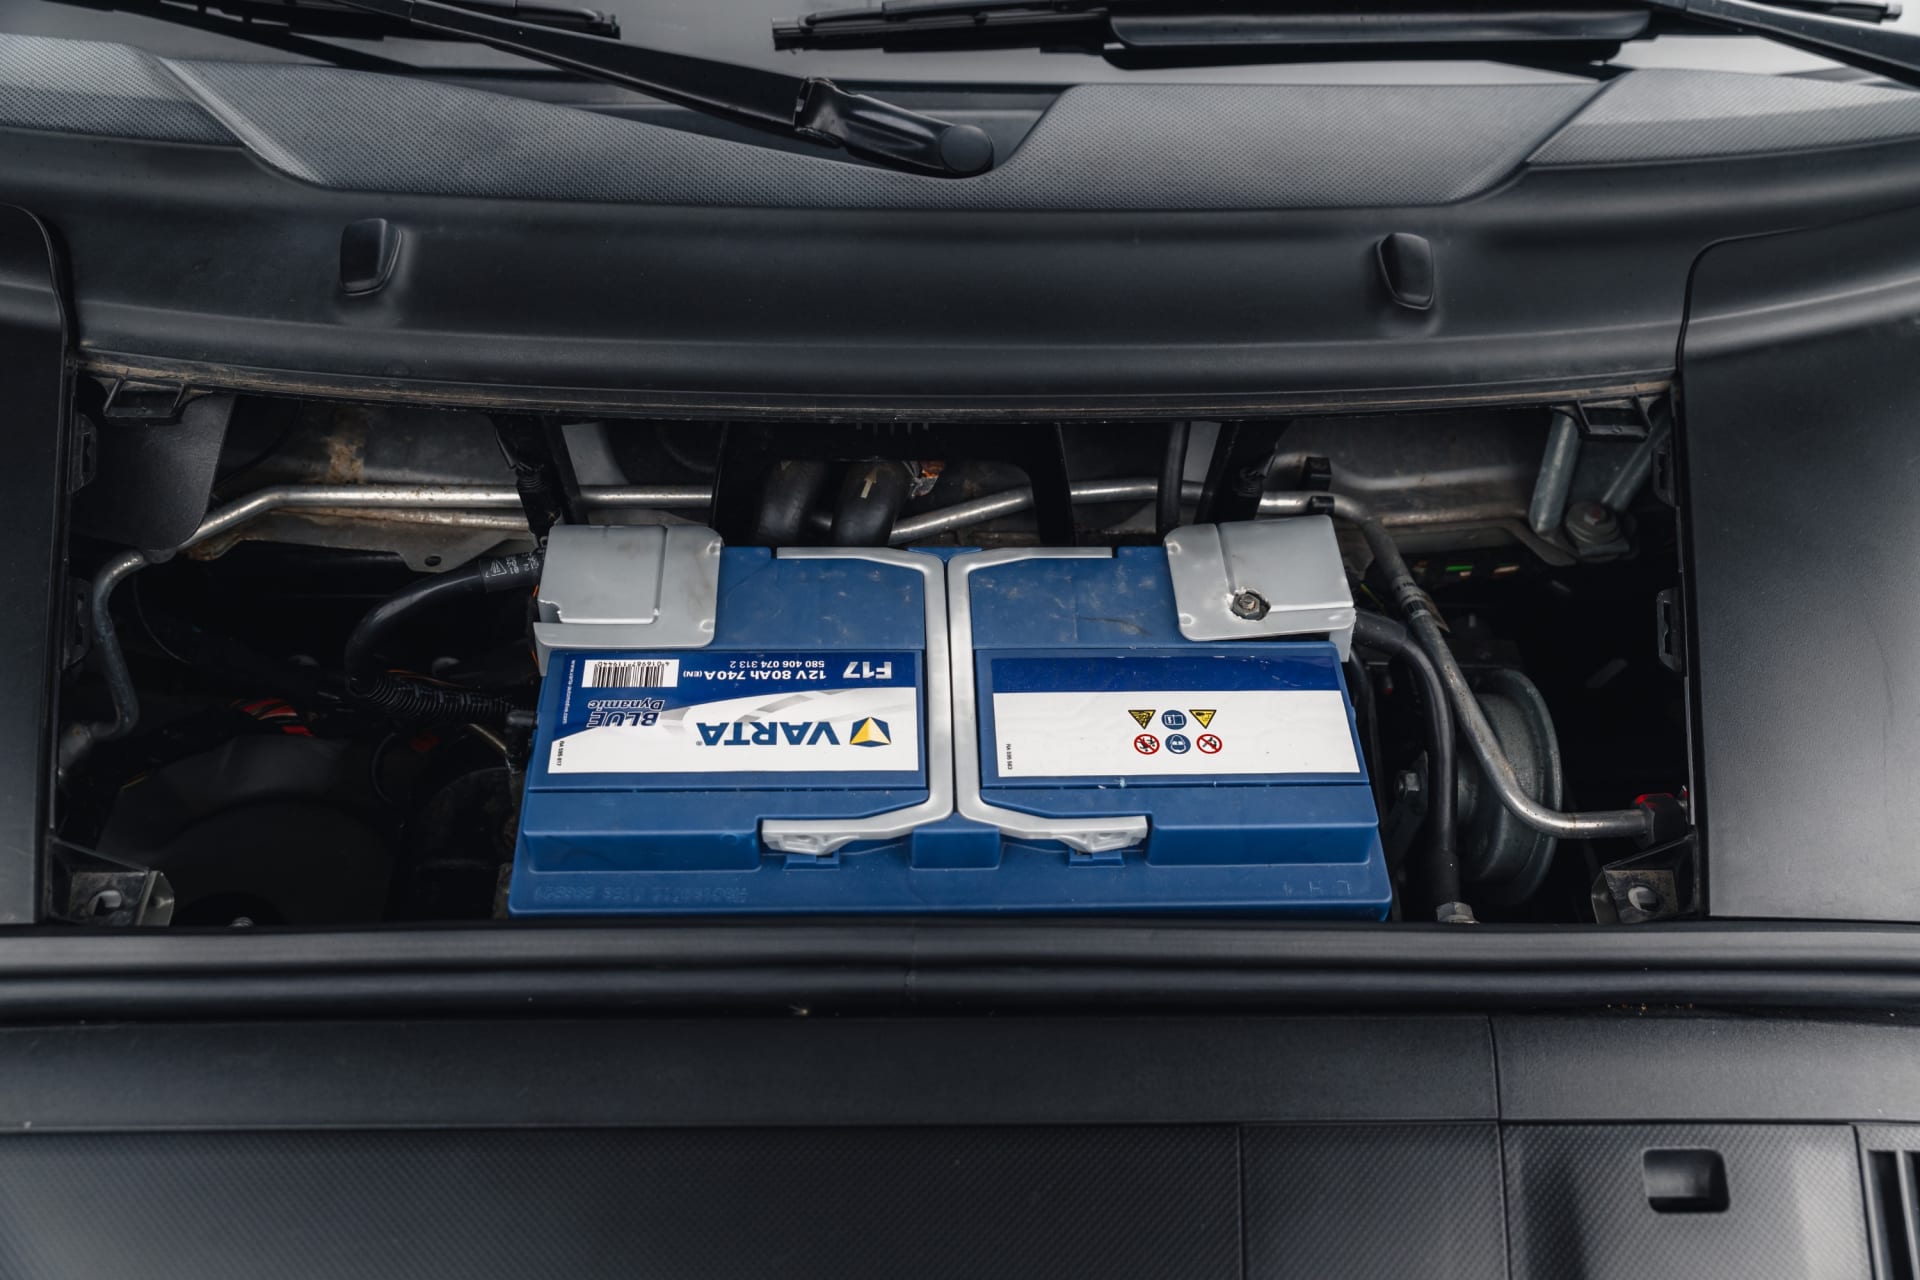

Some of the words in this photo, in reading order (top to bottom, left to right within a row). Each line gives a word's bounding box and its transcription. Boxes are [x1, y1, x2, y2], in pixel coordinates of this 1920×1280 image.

[729, 660, 736, 668] 2
[739, 660, 757, 668] 313
[760, 660, 780, 668] 074
[782, 660, 803, 668] 406
[805, 660, 825, 668] 580
[704, 670, 746, 680] 740A
[750, 670, 791, 680] 80Ah
[795, 670, 827, 680] 12V
[842, 661, 893, 679] F17
[588, 698, 665, 711] Dynamic
[586, 711, 661, 728] BLUE
